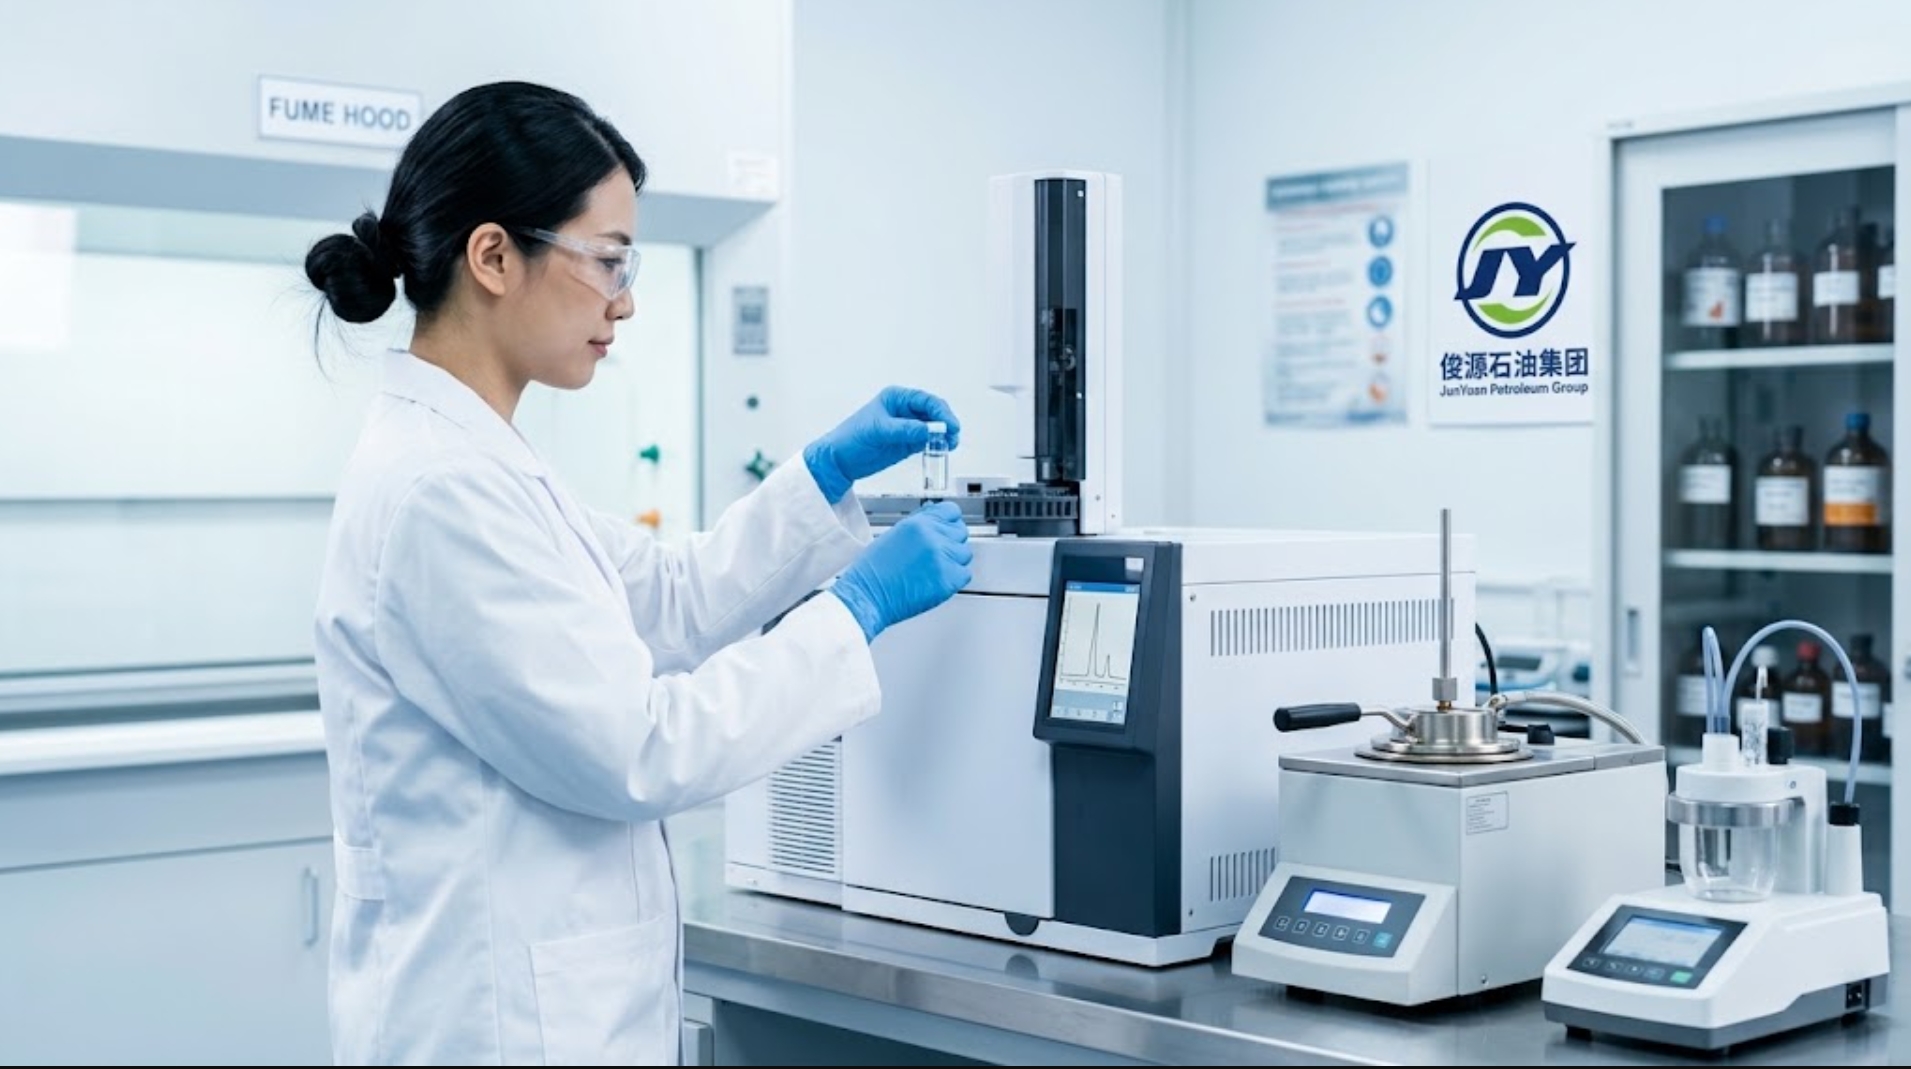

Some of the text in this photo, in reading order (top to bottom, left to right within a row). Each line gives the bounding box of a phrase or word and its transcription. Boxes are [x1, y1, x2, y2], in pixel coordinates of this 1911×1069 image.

[268, 97, 411, 131] FUME HOOD
[1440, 347, 1588, 380] 俊源石油集团
[1490, 382, 1549, 395] Petroleum
[1552, 380, 1588, 395] Group
